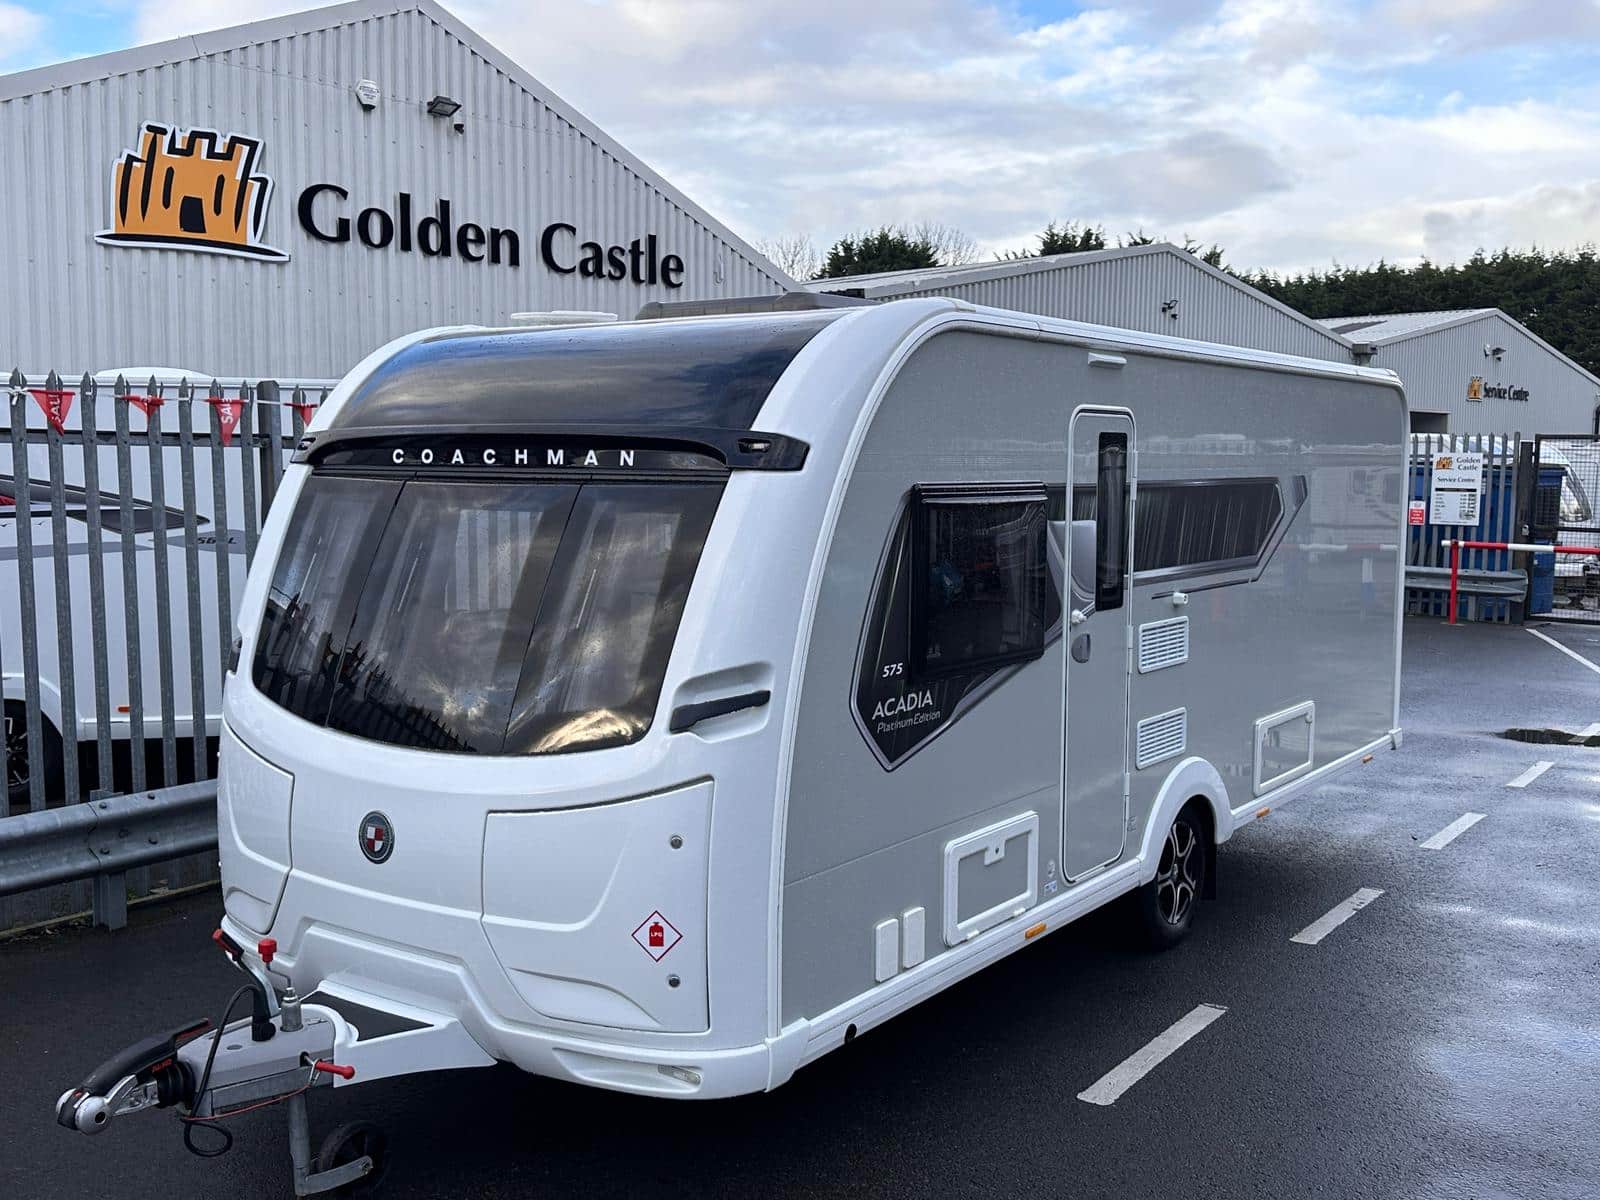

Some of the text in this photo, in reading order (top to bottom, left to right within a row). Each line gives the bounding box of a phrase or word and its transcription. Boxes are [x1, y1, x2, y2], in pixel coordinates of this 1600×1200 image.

[298, 183, 685, 289] Golden Castle
[1483, 382, 1530, 402] Service Centre
[392, 448, 636, 467] COACHMAN
[1456, 456, 1481, 464] Golden
[882, 662, 904, 678] 575
[871, 689, 933, 720] ACADIA
[877, 710, 941, 734] Platinum Edition
